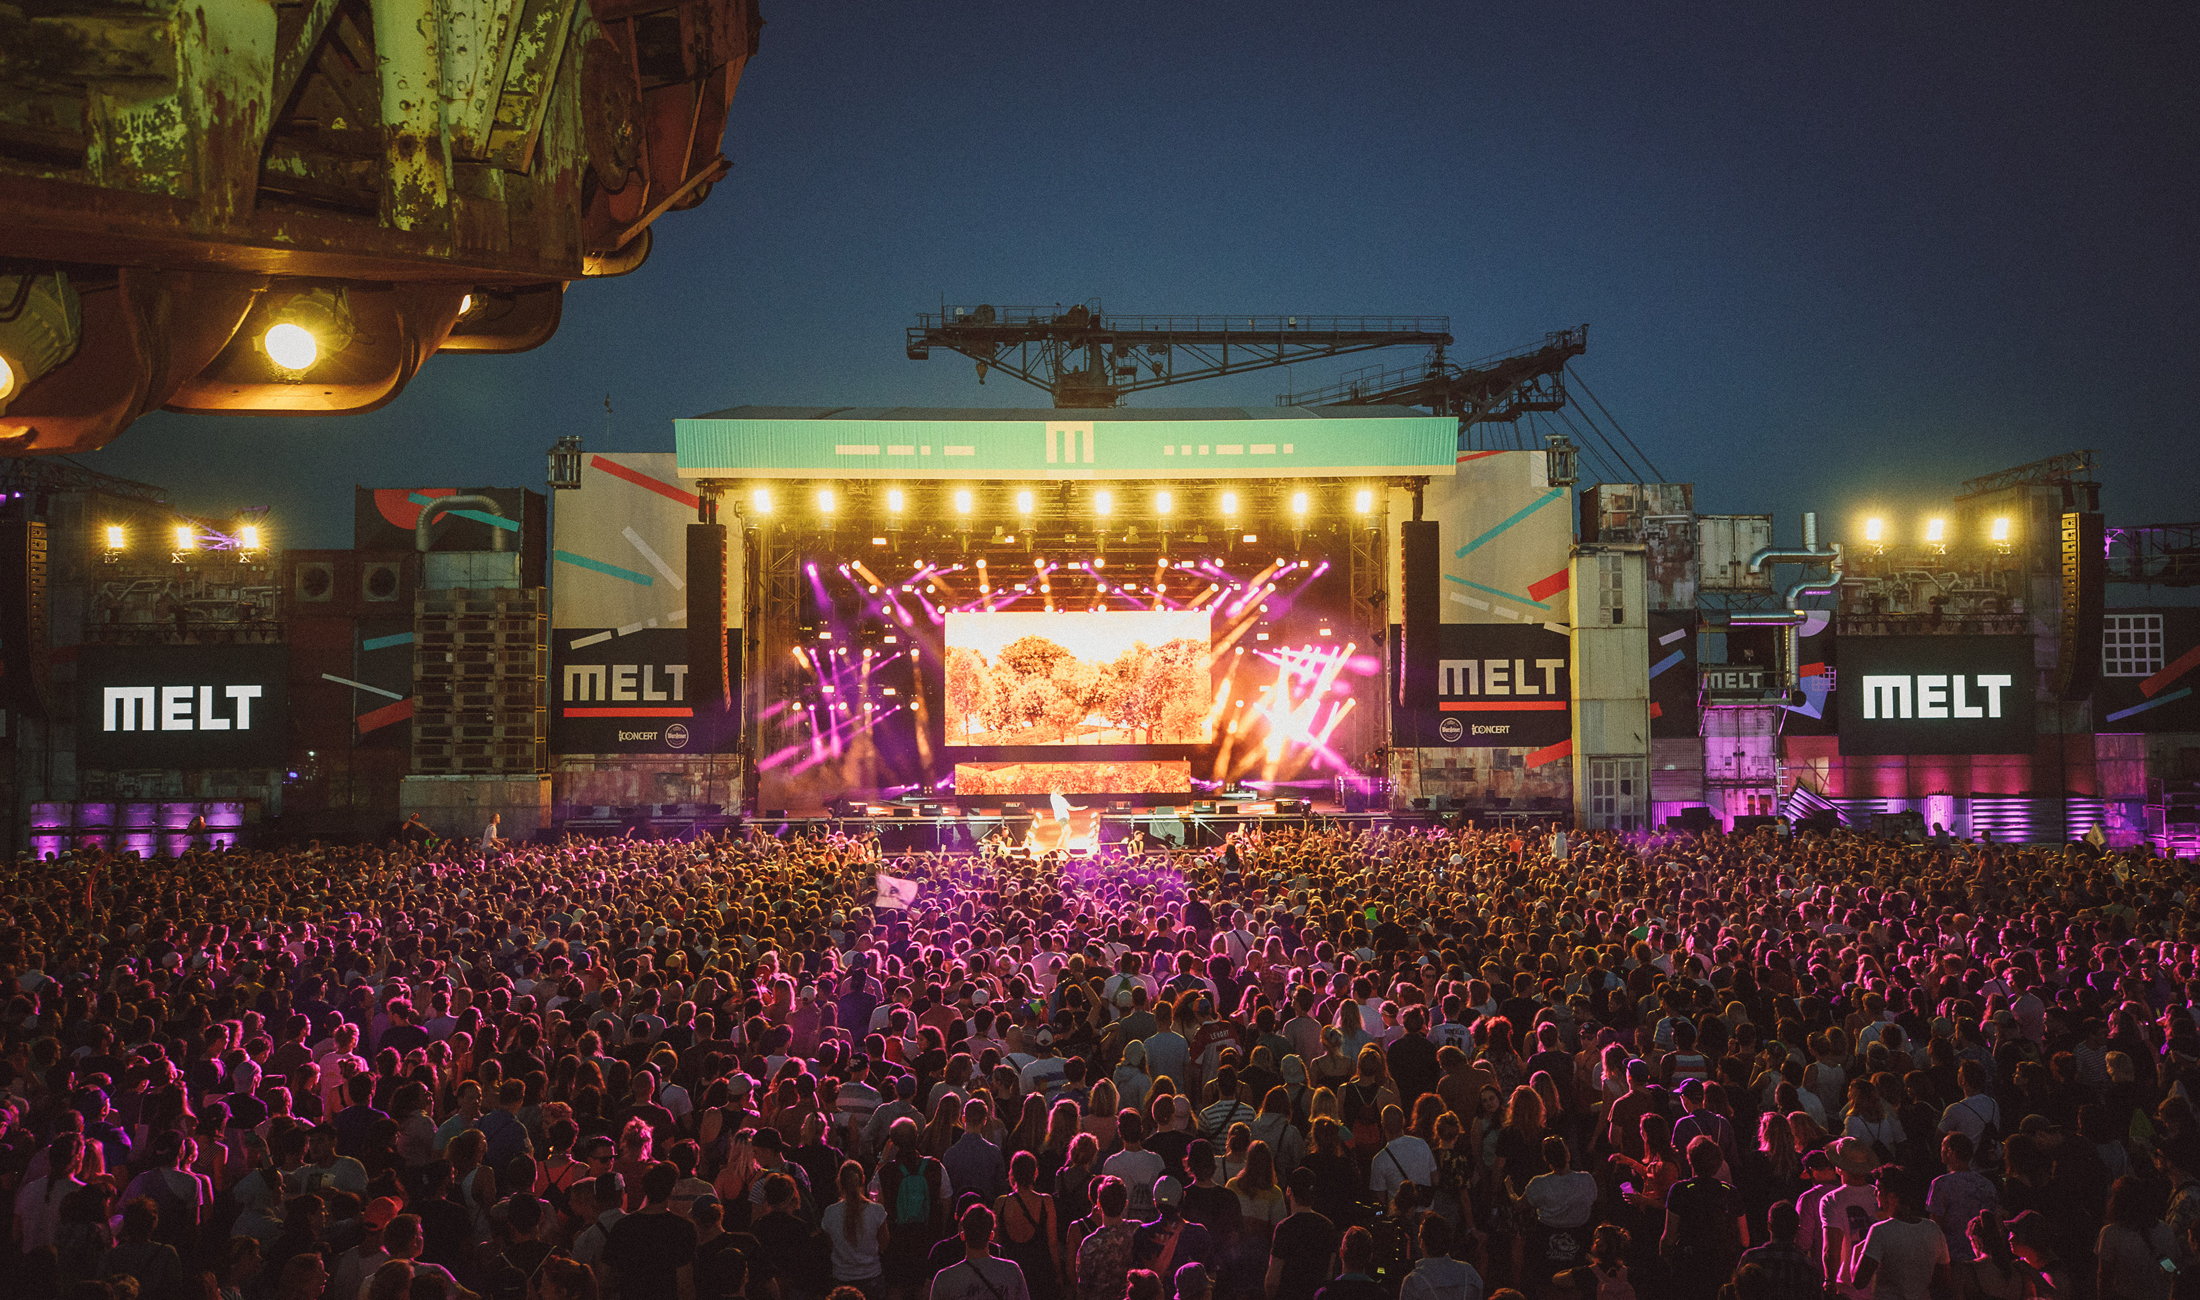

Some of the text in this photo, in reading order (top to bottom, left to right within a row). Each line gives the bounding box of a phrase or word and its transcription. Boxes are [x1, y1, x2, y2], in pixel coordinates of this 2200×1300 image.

[563, 664, 688, 700] MELT
[1439, 659, 1565, 695] MELT
[1702, 672, 1762, 689] MELT
[103, 685, 262, 731] MELT
[1862, 674, 2012, 719] MELT
